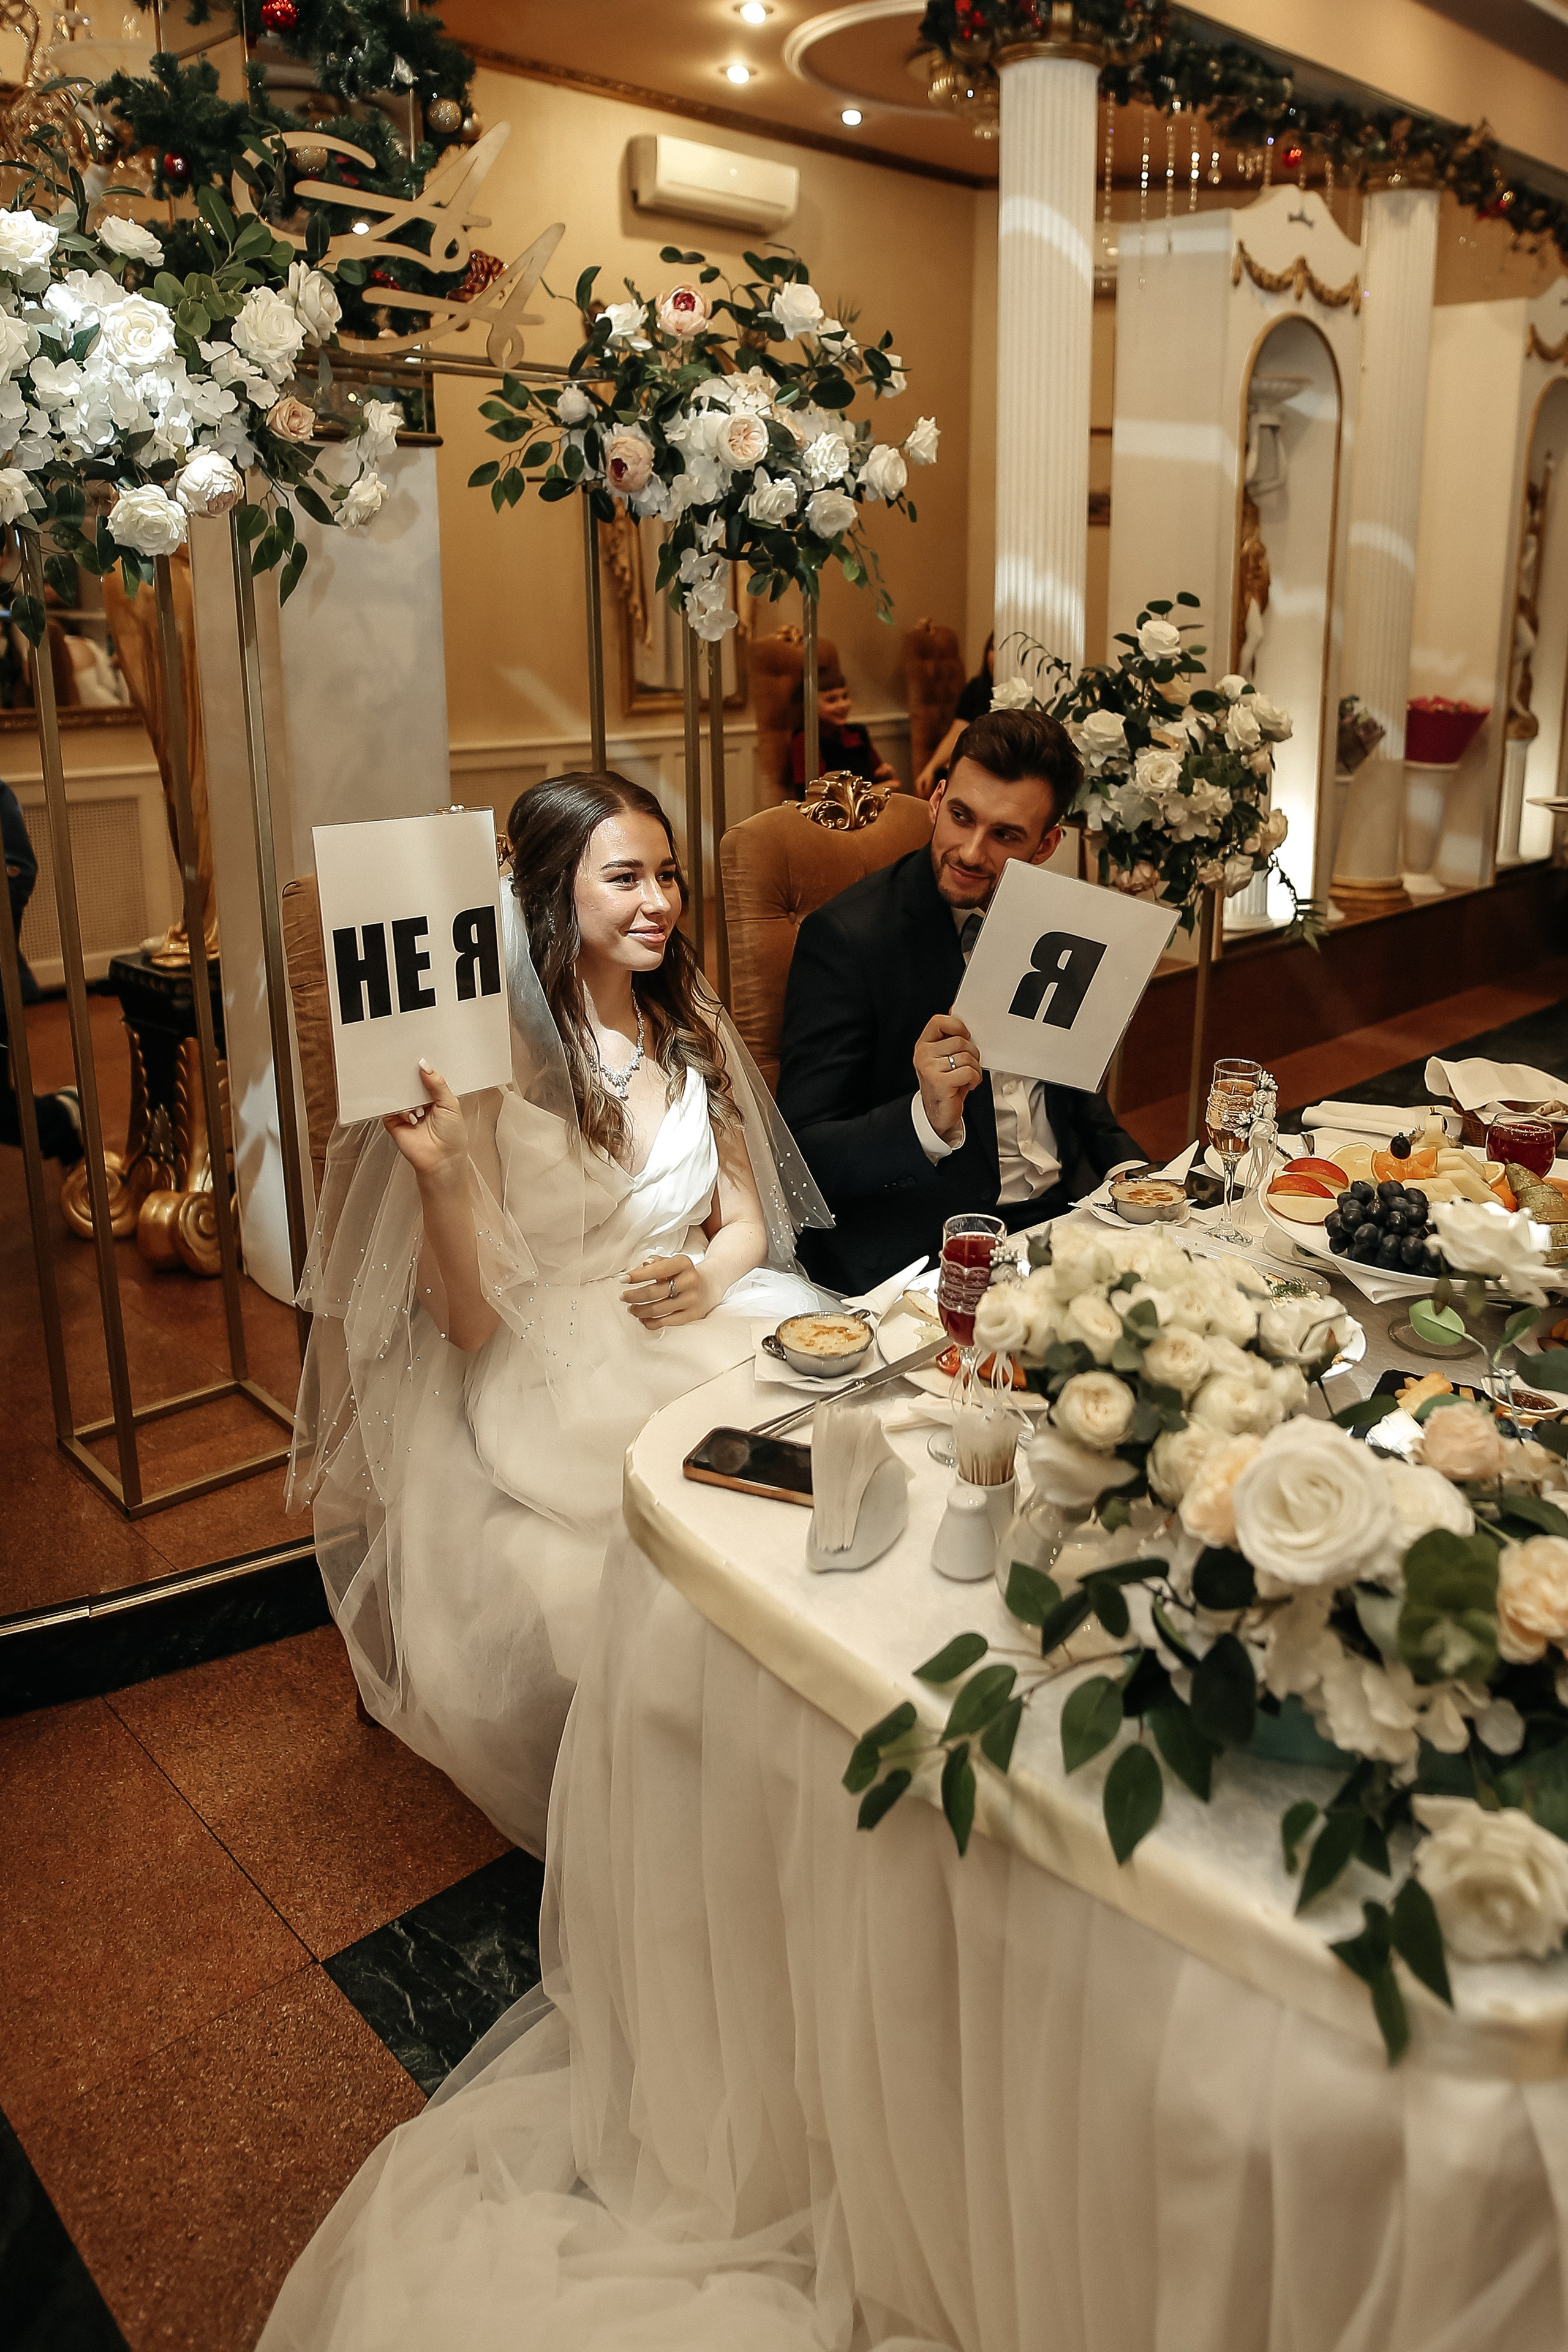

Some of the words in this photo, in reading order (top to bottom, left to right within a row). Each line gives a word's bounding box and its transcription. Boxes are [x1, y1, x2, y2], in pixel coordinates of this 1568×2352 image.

[332, 916, 436, 1025] НЕ
[452, 905, 501, 1001] Я
[1008, 931, 1108, 1030] Я
